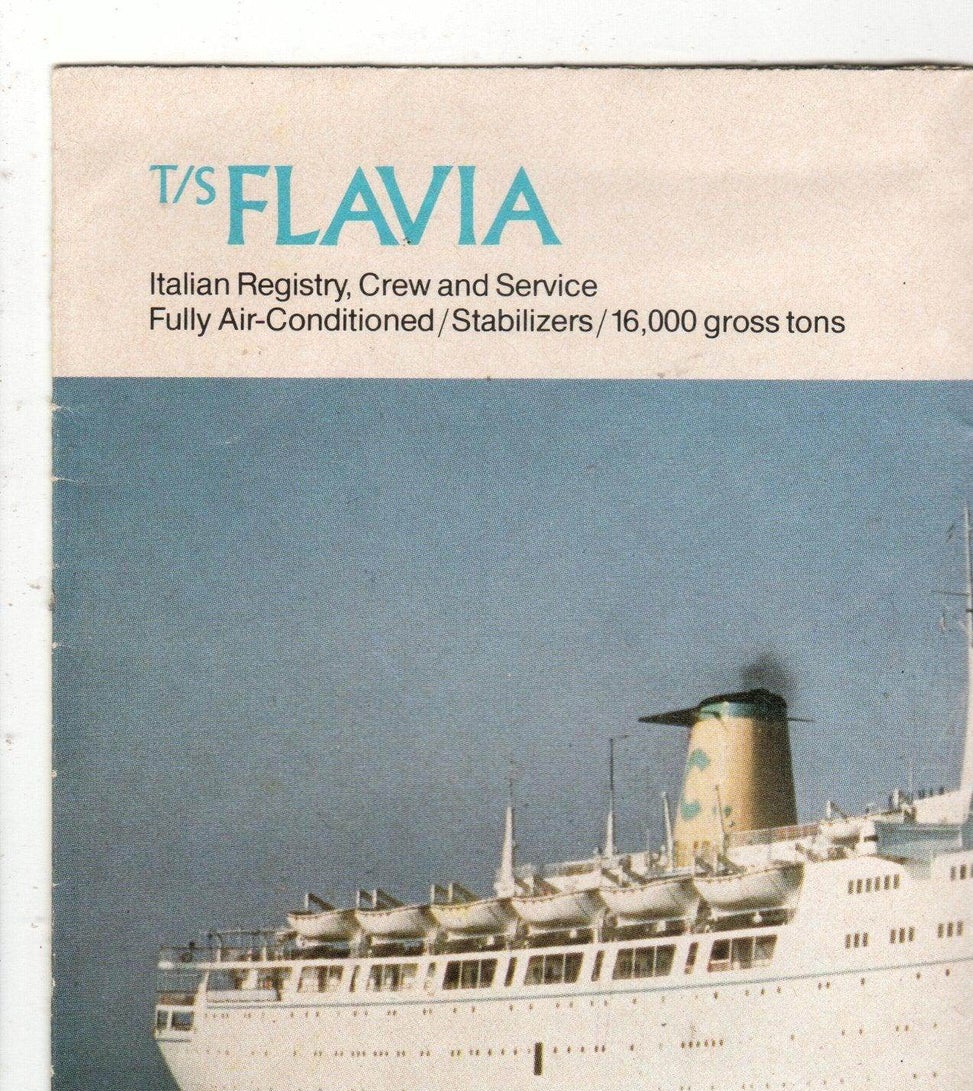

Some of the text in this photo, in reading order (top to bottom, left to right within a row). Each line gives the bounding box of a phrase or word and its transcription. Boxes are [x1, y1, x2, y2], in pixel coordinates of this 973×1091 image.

[151, 165, 560, 246] T/S FLAVIA
[150, 271, 598, 303] Italian Registry, Crew and Service
[150, 306, 212, 338] Fully
[703, 314, 780, 339] gross
[785, 310, 846, 334] tons
